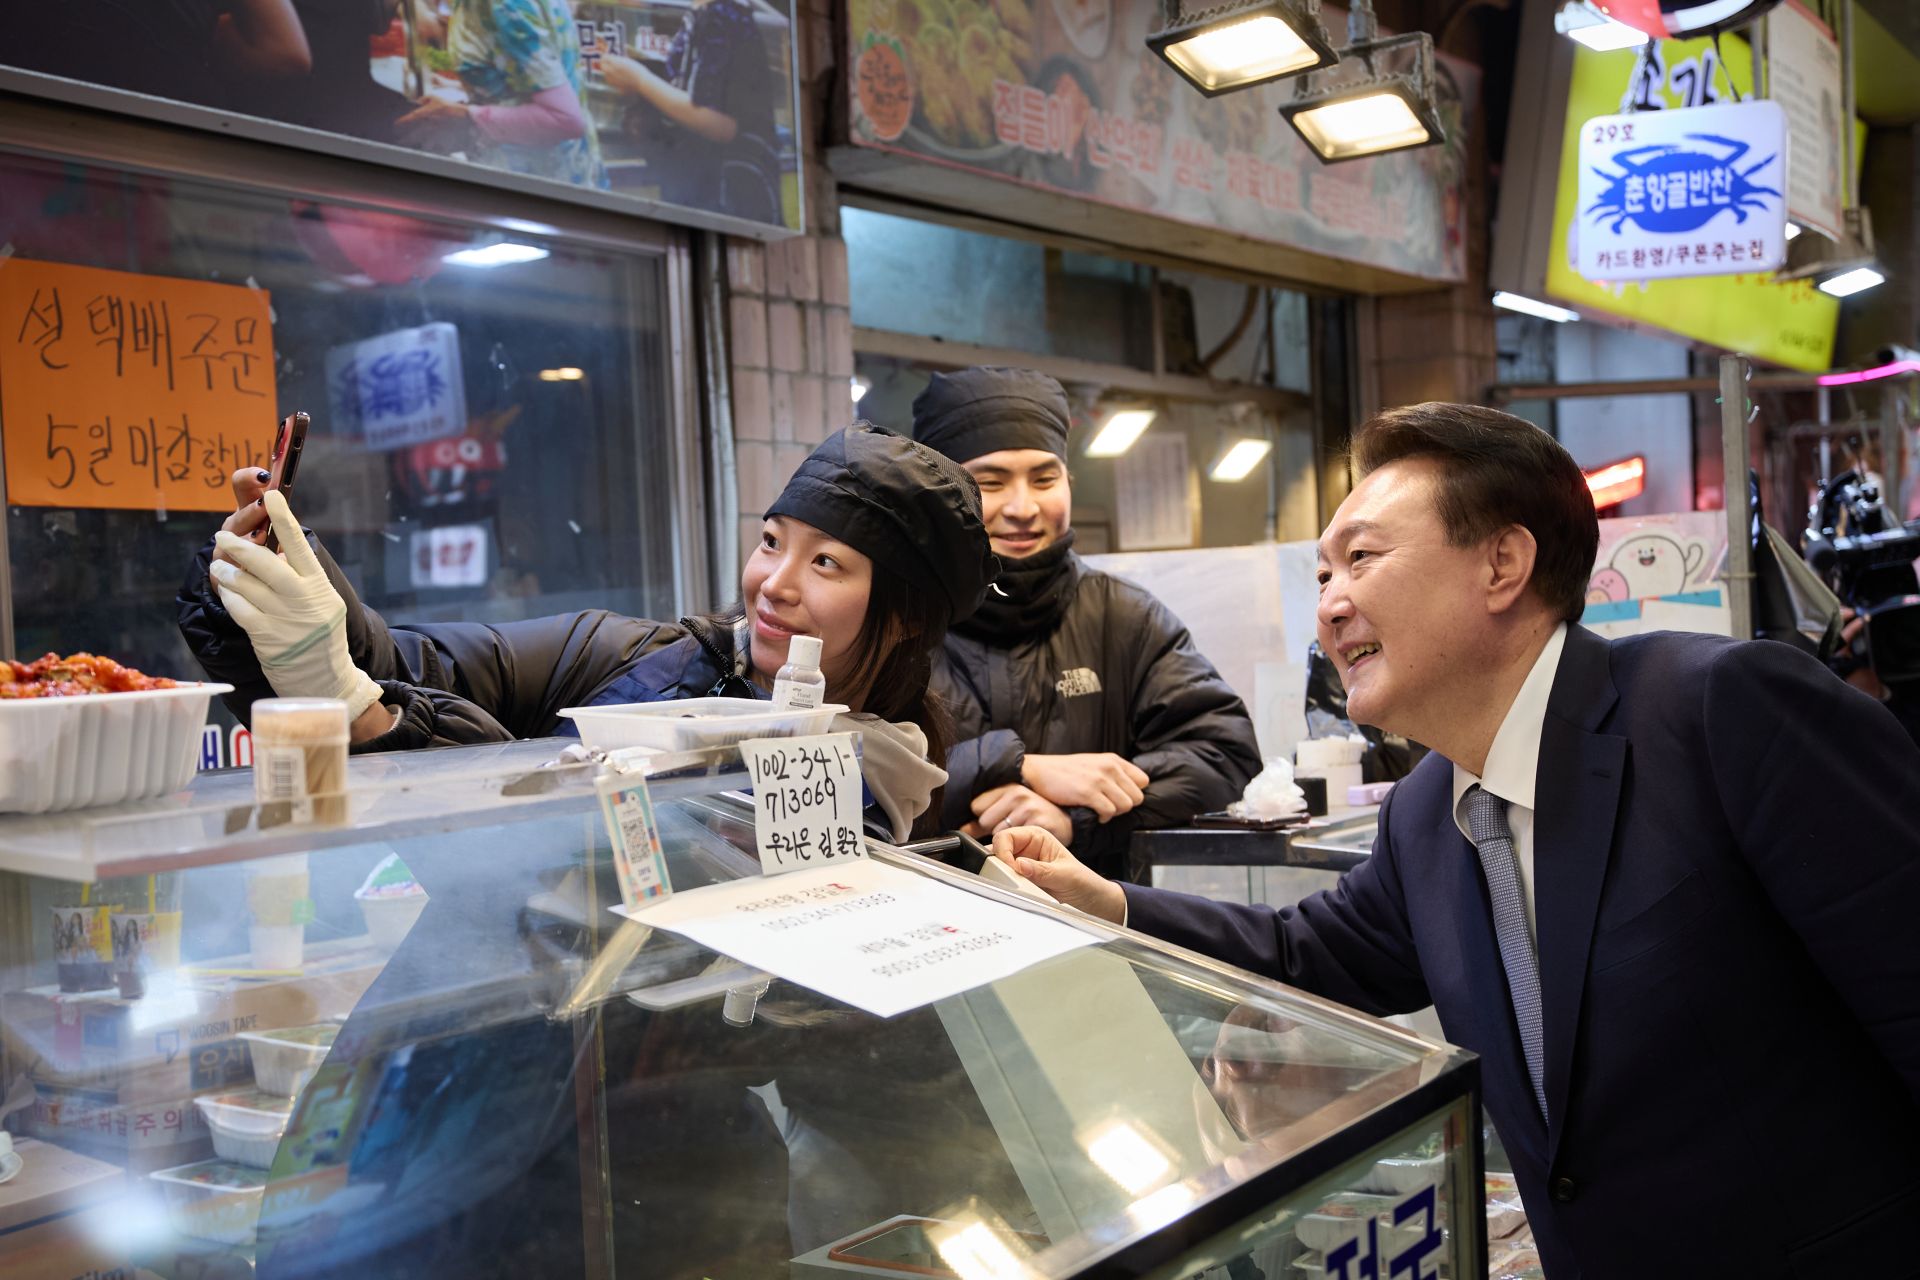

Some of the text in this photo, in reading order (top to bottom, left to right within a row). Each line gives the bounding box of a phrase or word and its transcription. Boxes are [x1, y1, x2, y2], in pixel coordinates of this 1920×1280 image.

[993, 80, 1074, 159] 집들이
[1593, 124, 1635, 144] 29호
[1624, 166, 1732, 214] 춘향골반찬
[1597, 239, 1764, 269] 카드환영/쿠폰주는집
[18, 287, 70, 370] 설
[86, 295, 175, 391] 택배
[180, 313, 267, 397] 주문
[47, 414, 116, 490] 5일
[1062, 669, 1081, 680] THE
[755, 745, 851, 784] 1002-341-
[765, 777, 837, 823] 713069
[818, 826, 835, 859] 김
[232, 1014, 257, 1033] TAPE
[134, 1108, 183, 1137] 주의
